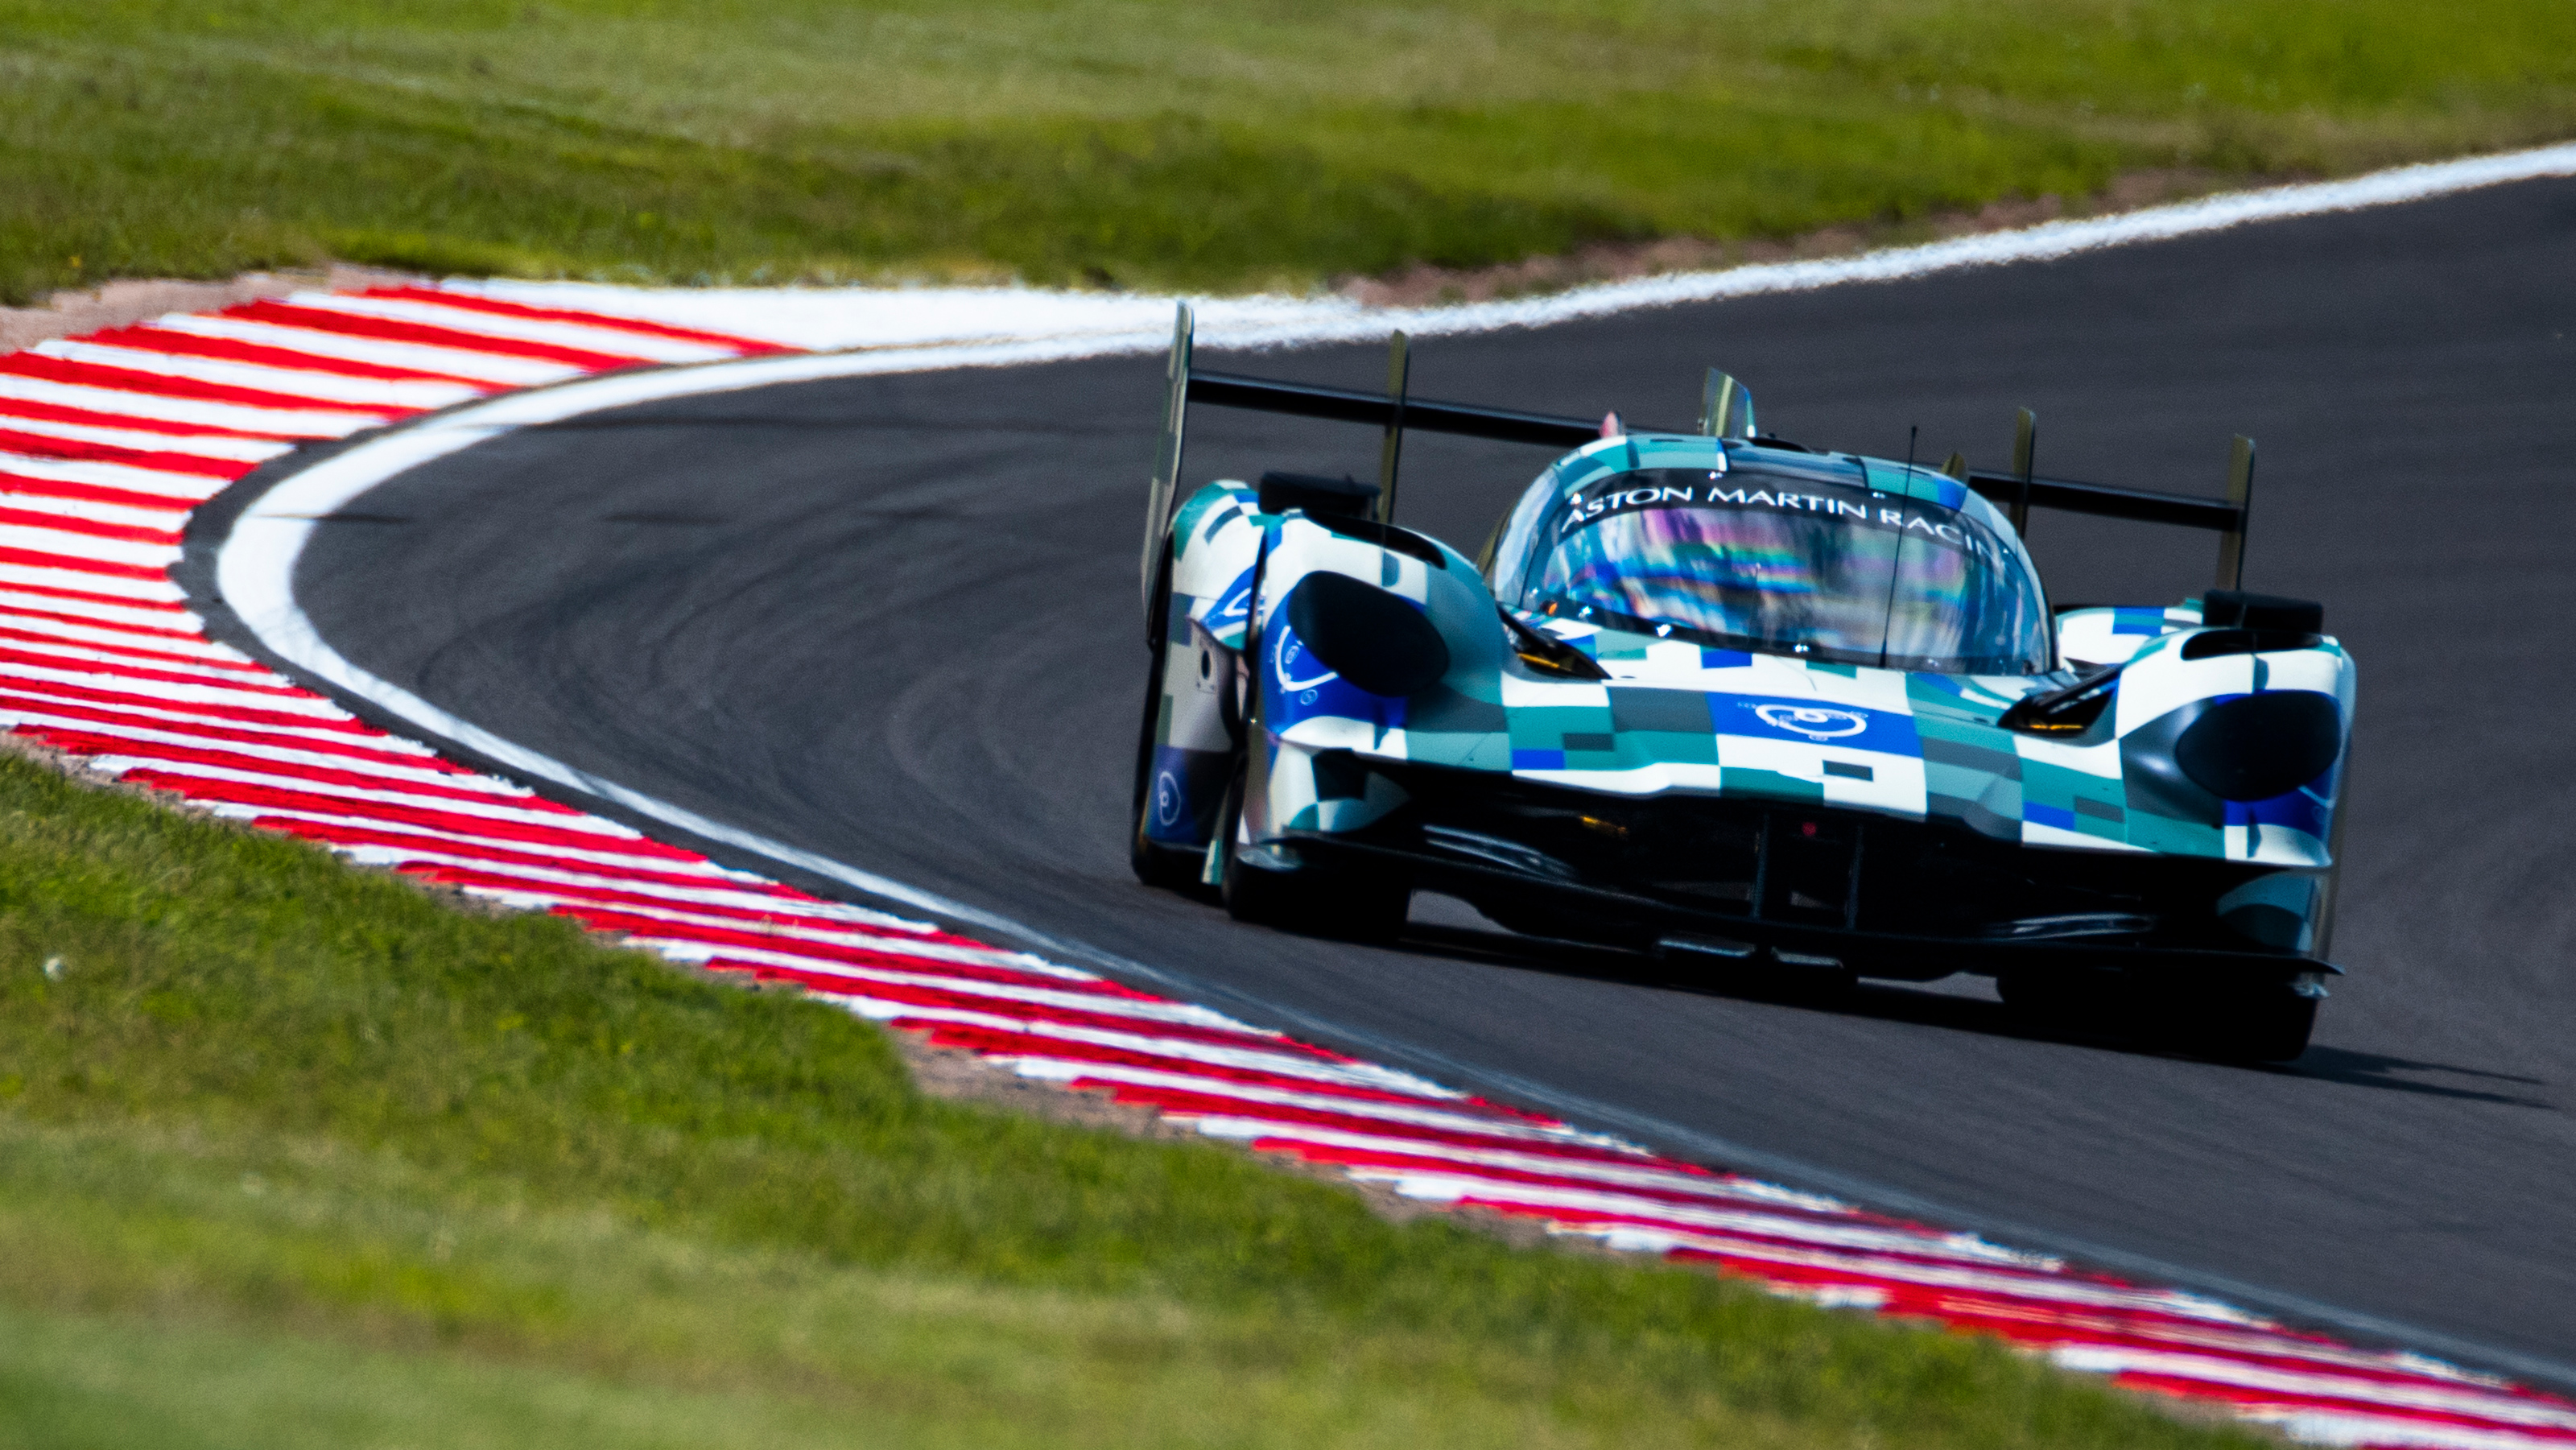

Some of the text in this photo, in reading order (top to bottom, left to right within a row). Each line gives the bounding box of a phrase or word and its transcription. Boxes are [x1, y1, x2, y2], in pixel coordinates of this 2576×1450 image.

[1560, 485, 1999, 563] ASTON MARTIN RACIN
